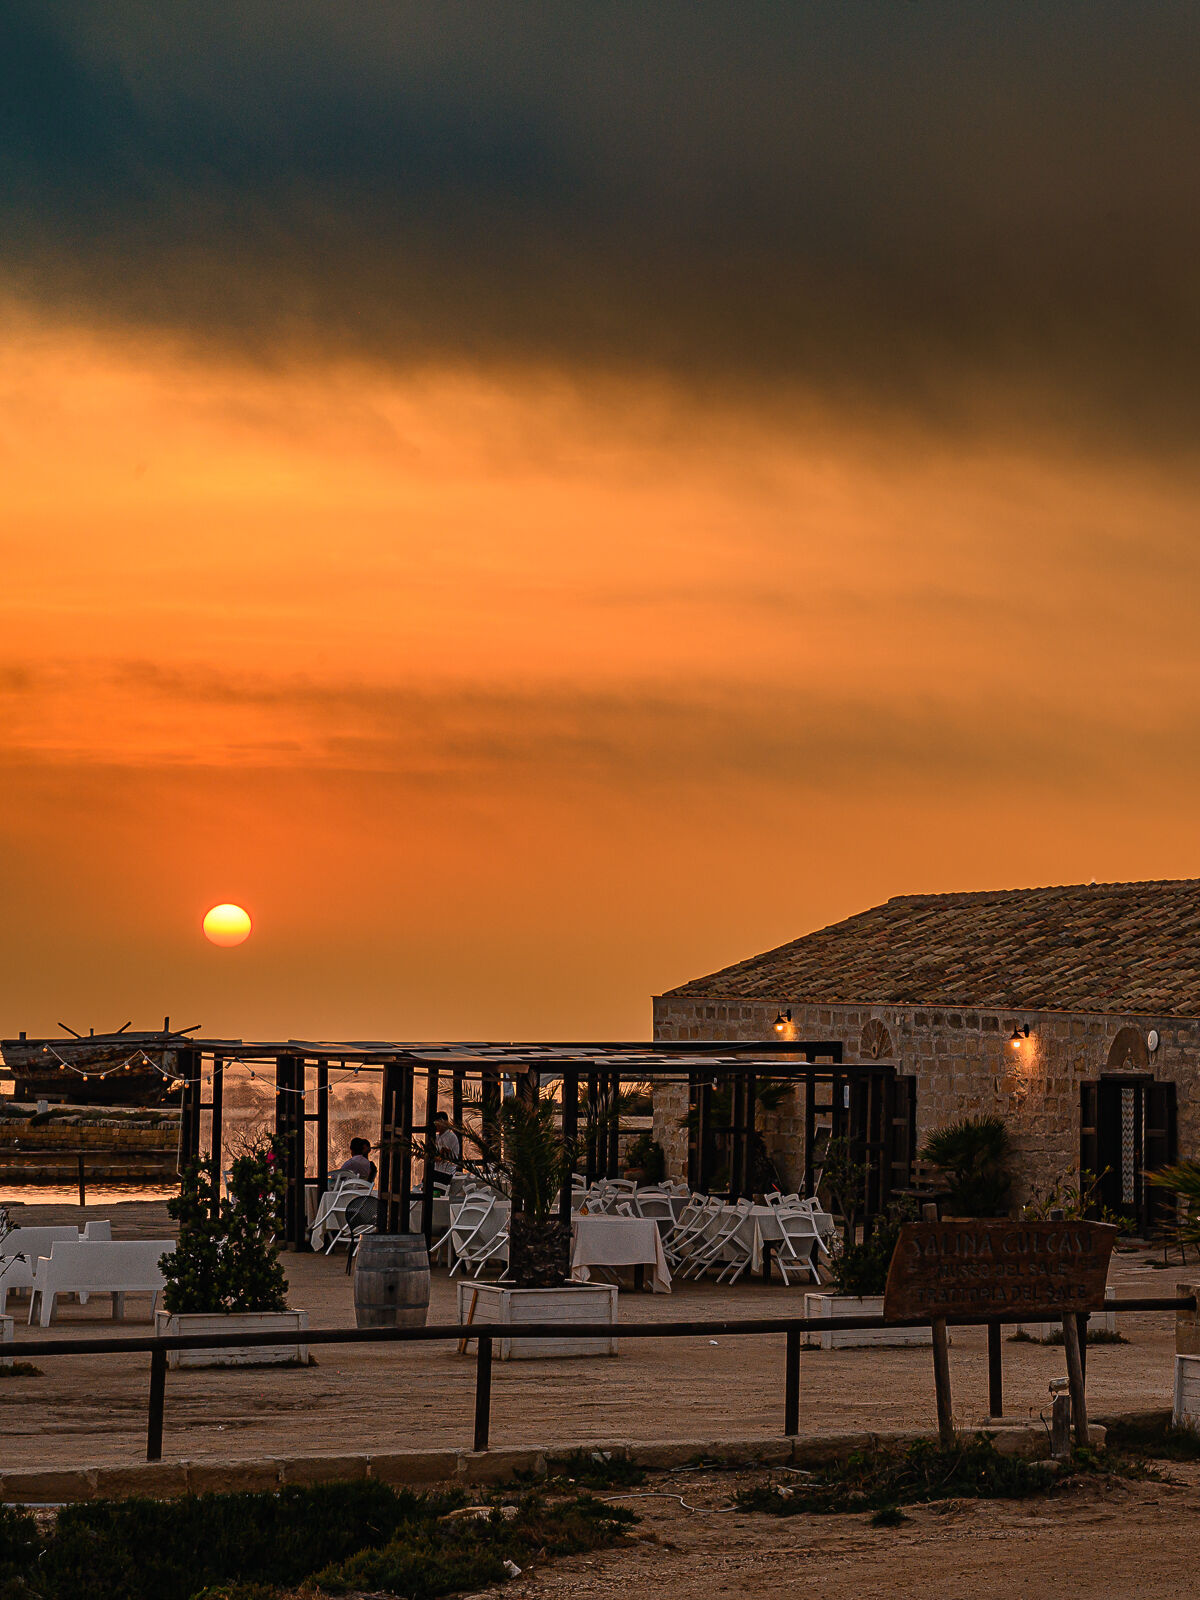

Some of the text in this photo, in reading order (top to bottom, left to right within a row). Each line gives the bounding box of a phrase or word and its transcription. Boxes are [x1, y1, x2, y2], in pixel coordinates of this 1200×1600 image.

[910, 1231, 993, 1257] SALINA
[1011, 1285, 1042, 1301] DEL
[1046, 1283, 1087, 1302] SALE
